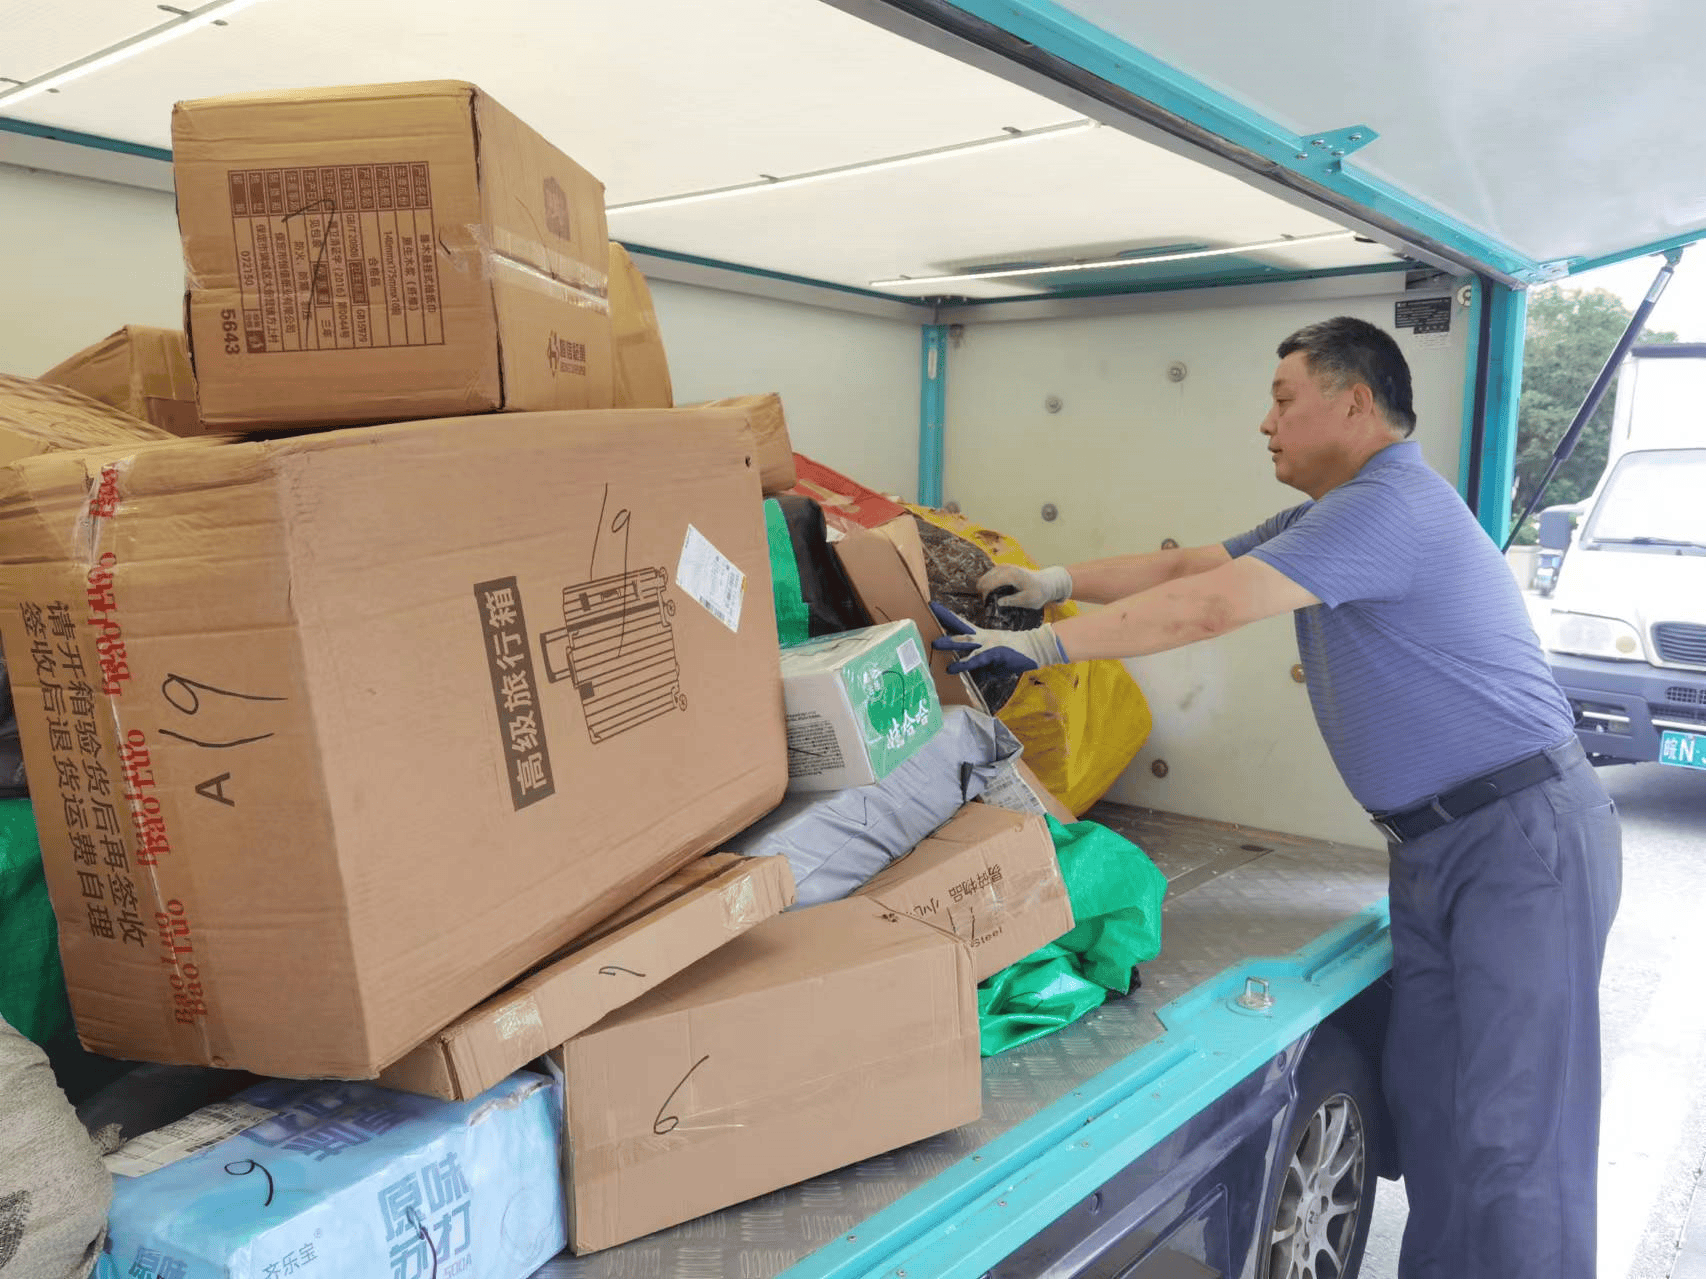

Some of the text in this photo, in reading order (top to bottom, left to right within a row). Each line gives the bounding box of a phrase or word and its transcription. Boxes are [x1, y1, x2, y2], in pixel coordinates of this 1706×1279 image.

[221, 309, 240, 354] 5643
[484, 587, 548, 796] 高级旅行箱
[20, 602, 117, 942] 签收后退货运费自理
[46, 601, 148, 948] 请开箱验货后再签收
[194, 772, 235, 807] A
[949, 864, 1003, 903] 易碎物品
[653, 1054, 710, 1136] 6
[224, 1159, 274, 1208] 9
[377, 1152, 470, 1241] 原味
[262, 1243, 318, 1279] 齐乐宝
